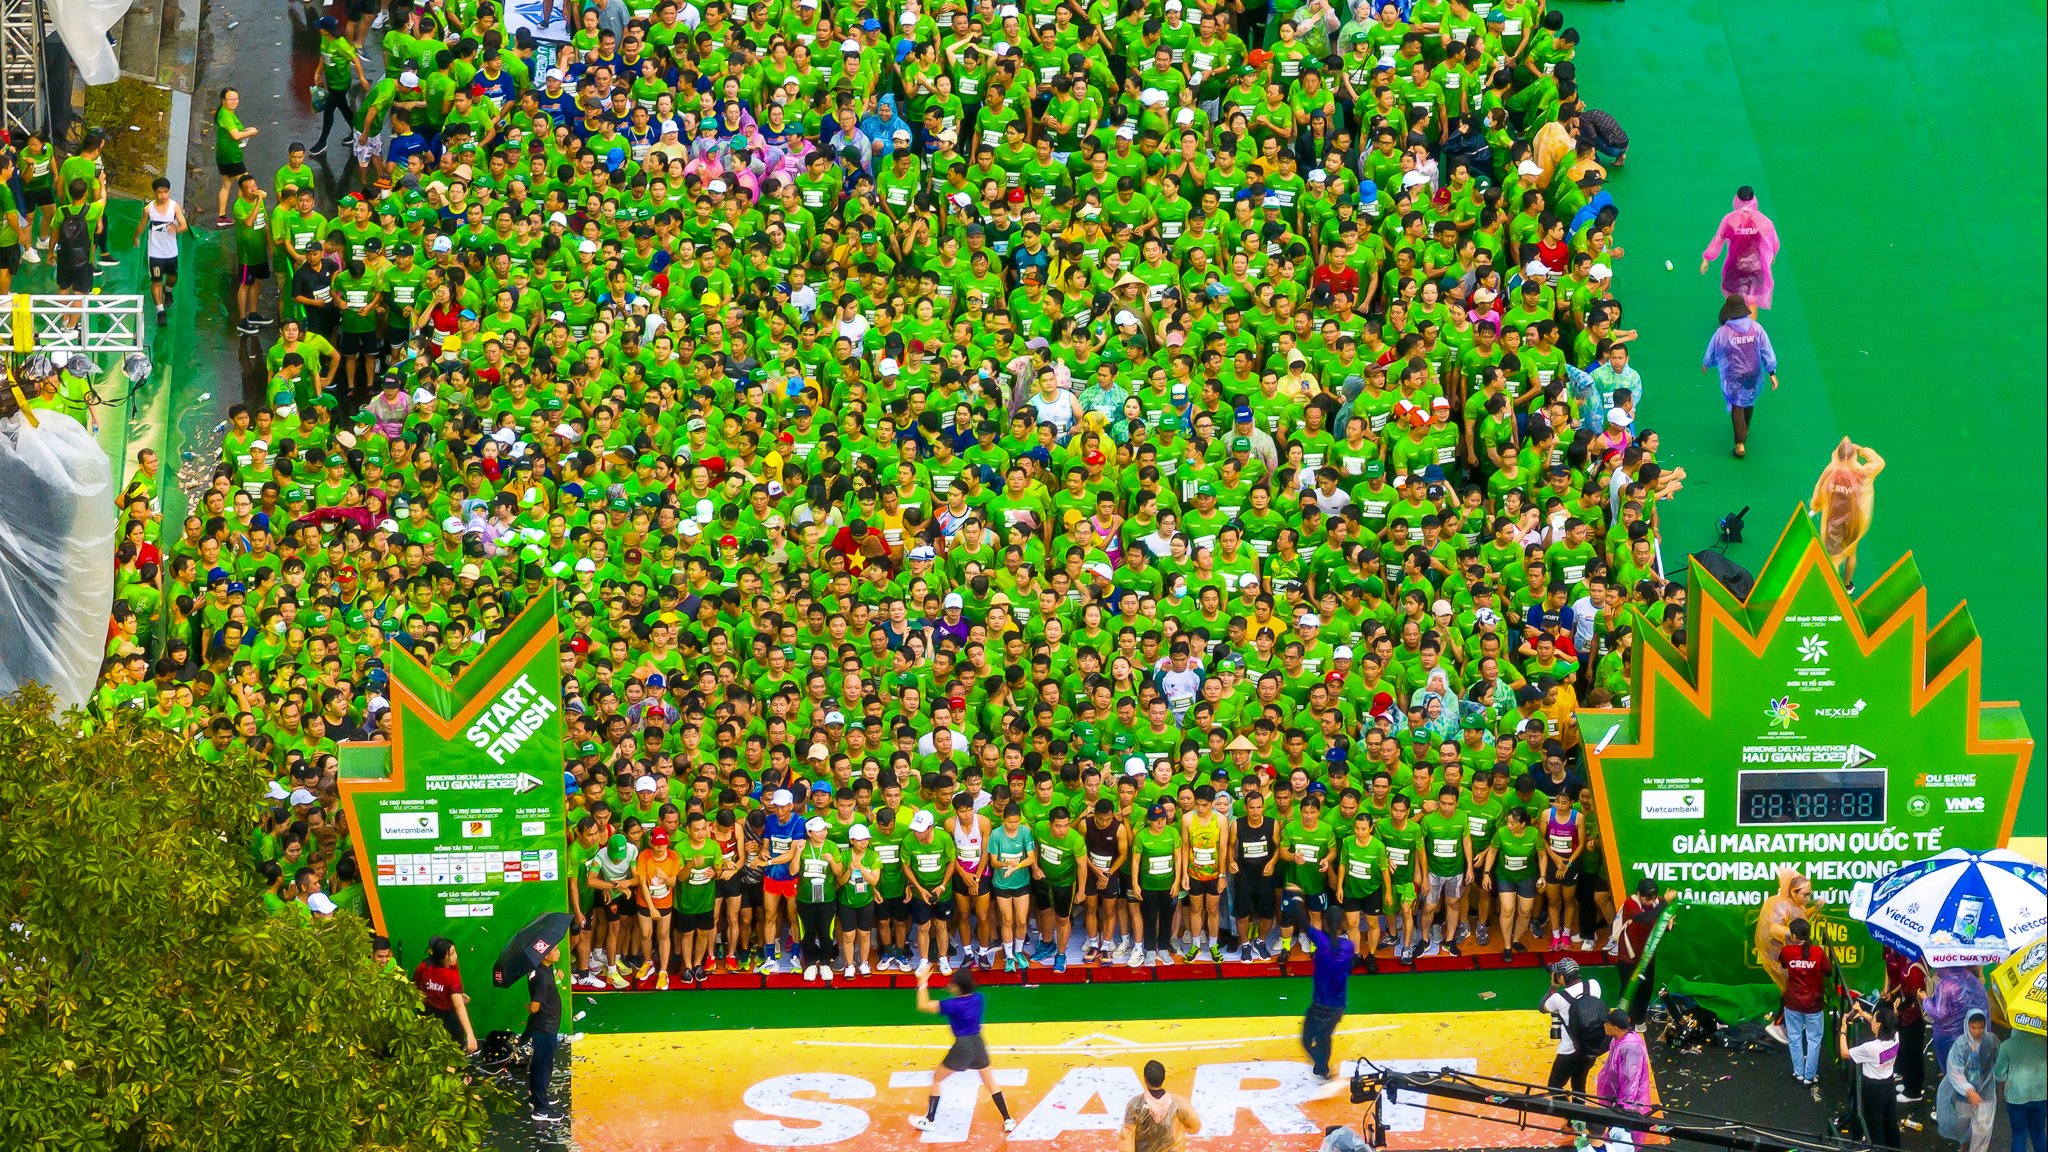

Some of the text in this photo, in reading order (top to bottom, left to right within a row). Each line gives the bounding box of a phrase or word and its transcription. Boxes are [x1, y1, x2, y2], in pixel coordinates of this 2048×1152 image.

[466, 673, 538, 748] START
[1815, 708, 1859, 719] NEXUS
[486, 694, 558, 765] FINISH
[1743, 752, 1847, 763] HAU GIANG 2023
[426, 780, 517, 791] HAU GIANG 2023
[1945, 796, 1985, 810] VNMS
[385, 826, 434, 834] Vietcombank
[1672, 826, 1945, 854] GIẢI MARATHON QUỐC TẾ
[1805, 860, 1897, 880] MEKONG
[1708, 890, 1762, 906] GIANG
[1885, 906, 1925, 933] Vietcoco
[1788, 960, 1816, 969] CREW
[732, 1057, 1478, 1147] START
